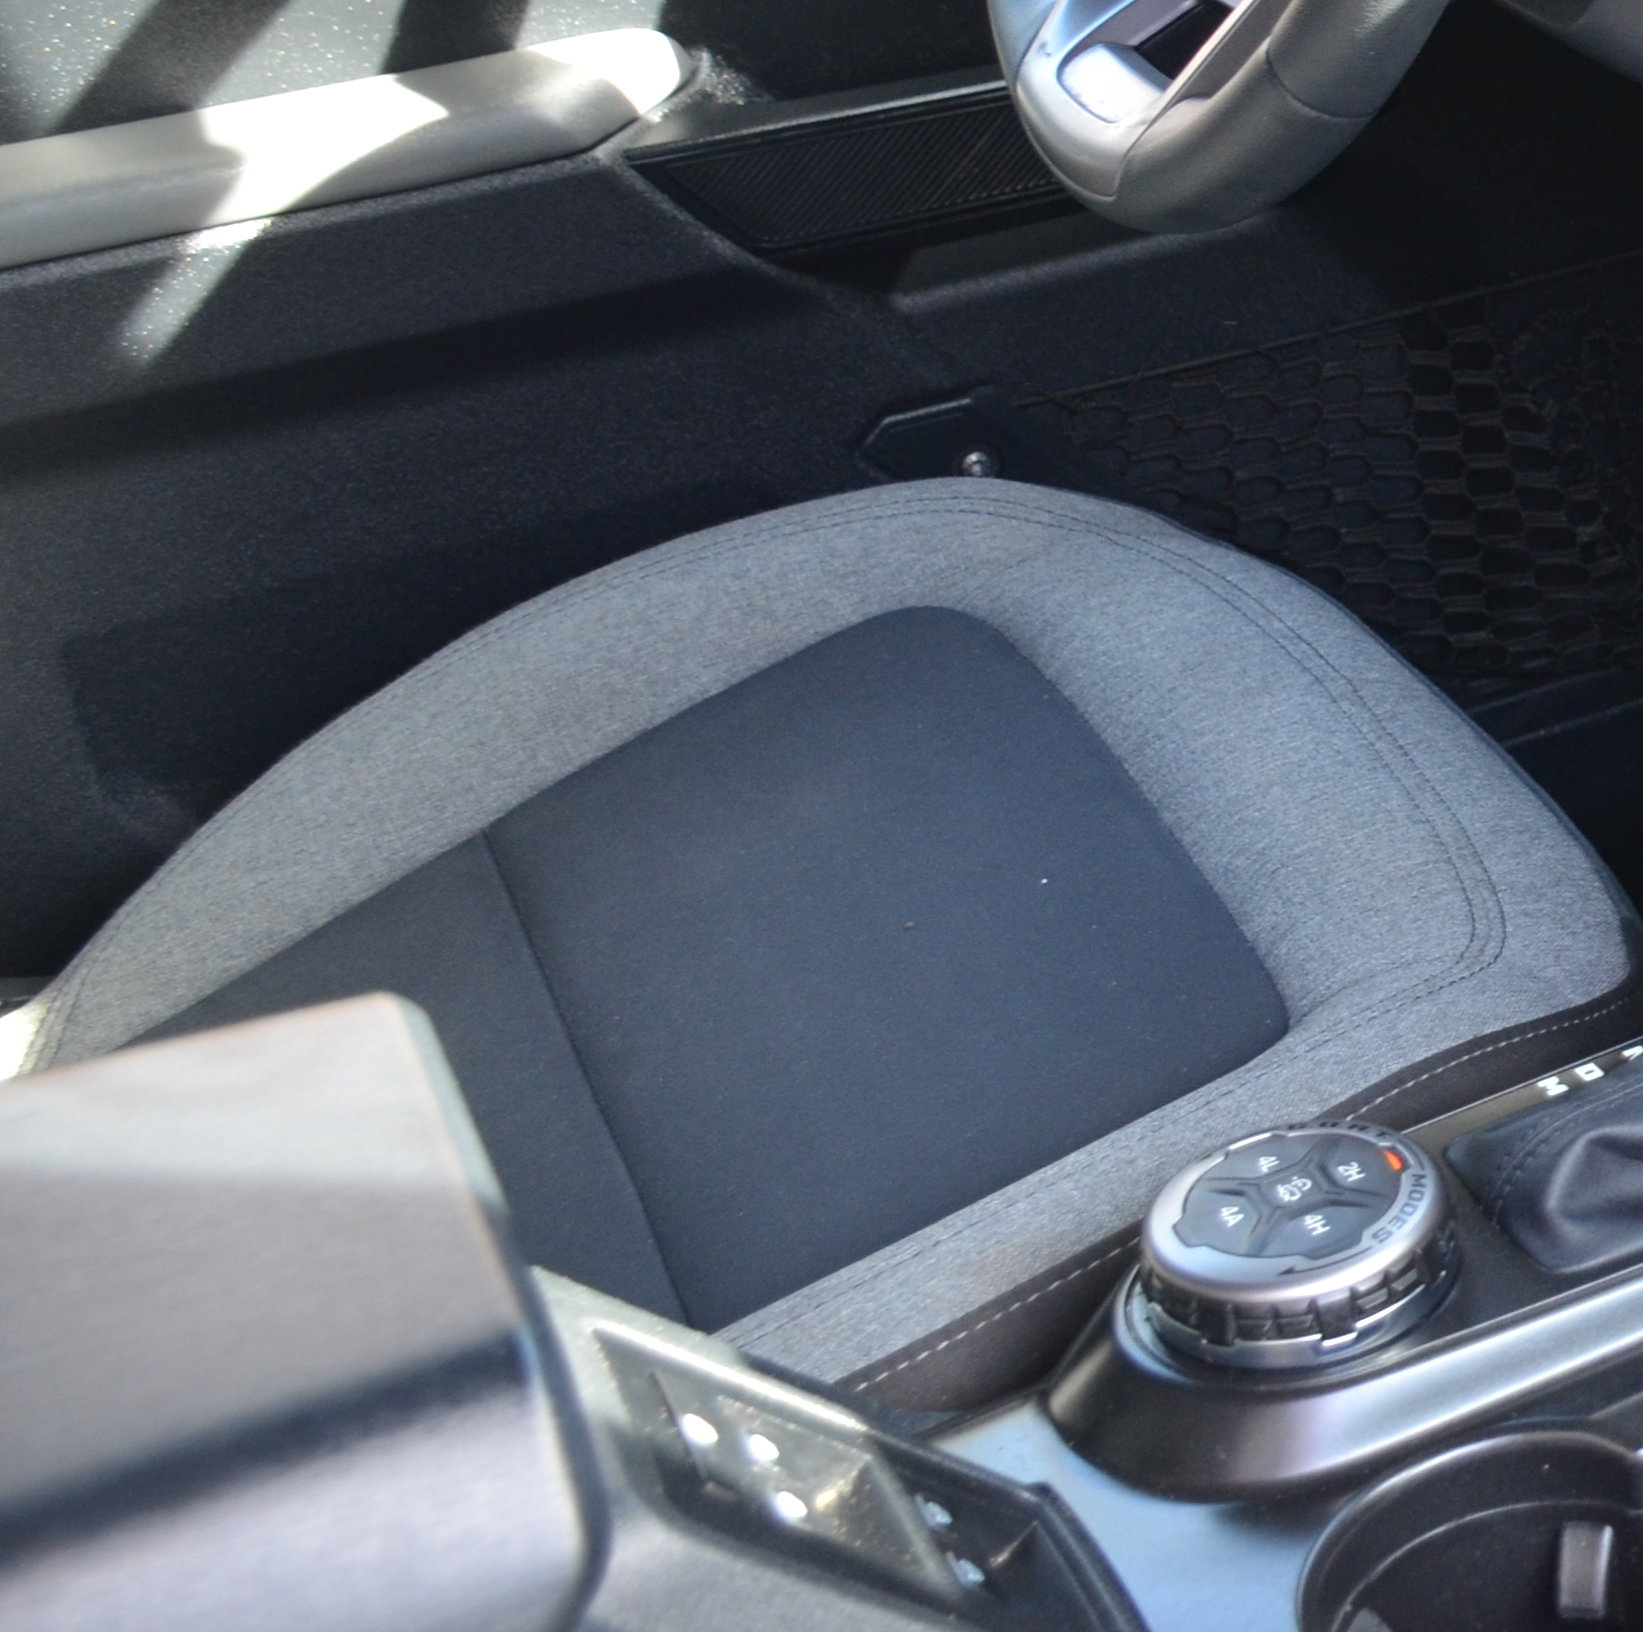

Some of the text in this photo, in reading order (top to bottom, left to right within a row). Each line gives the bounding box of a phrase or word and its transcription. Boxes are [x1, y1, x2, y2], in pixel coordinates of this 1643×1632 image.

[1258, 1156, 1279, 1173] 4L
[1338, 1162, 1365, 1181] 2H
[1220, 1206, 1245, 1227] 4A
[1371, 1173, 1428, 1245] MODES
[1304, 1214, 1331, 1236] 4H
